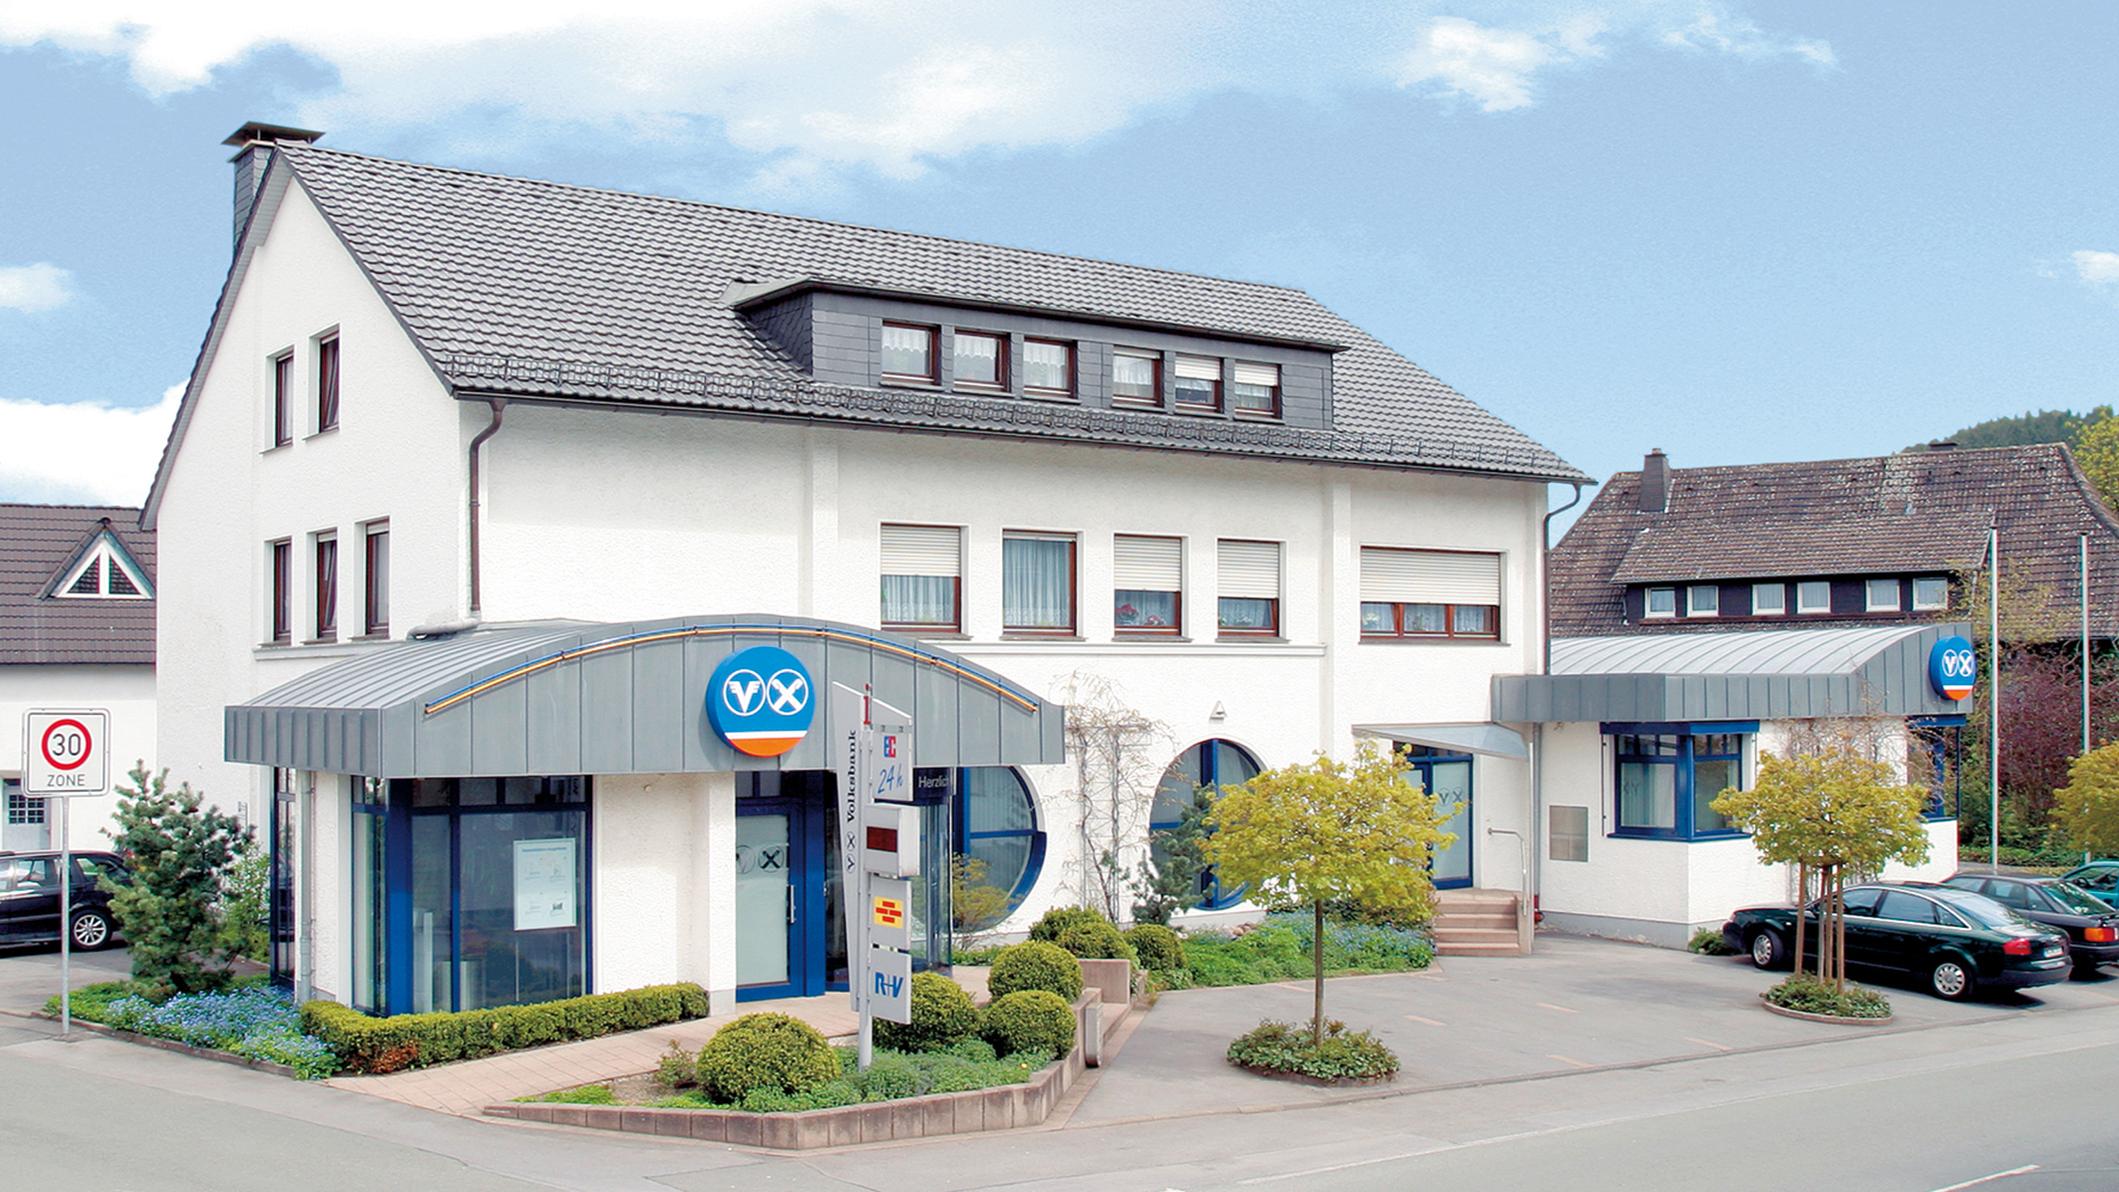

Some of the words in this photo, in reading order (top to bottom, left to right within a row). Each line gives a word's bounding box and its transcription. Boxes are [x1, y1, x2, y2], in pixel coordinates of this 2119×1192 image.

[52, 733, 81, 756] 30
[47, 774, 85, 787] ZONE
[846, 729, 857, 823] Volksbank
[877, 765, 895, 794] 24
